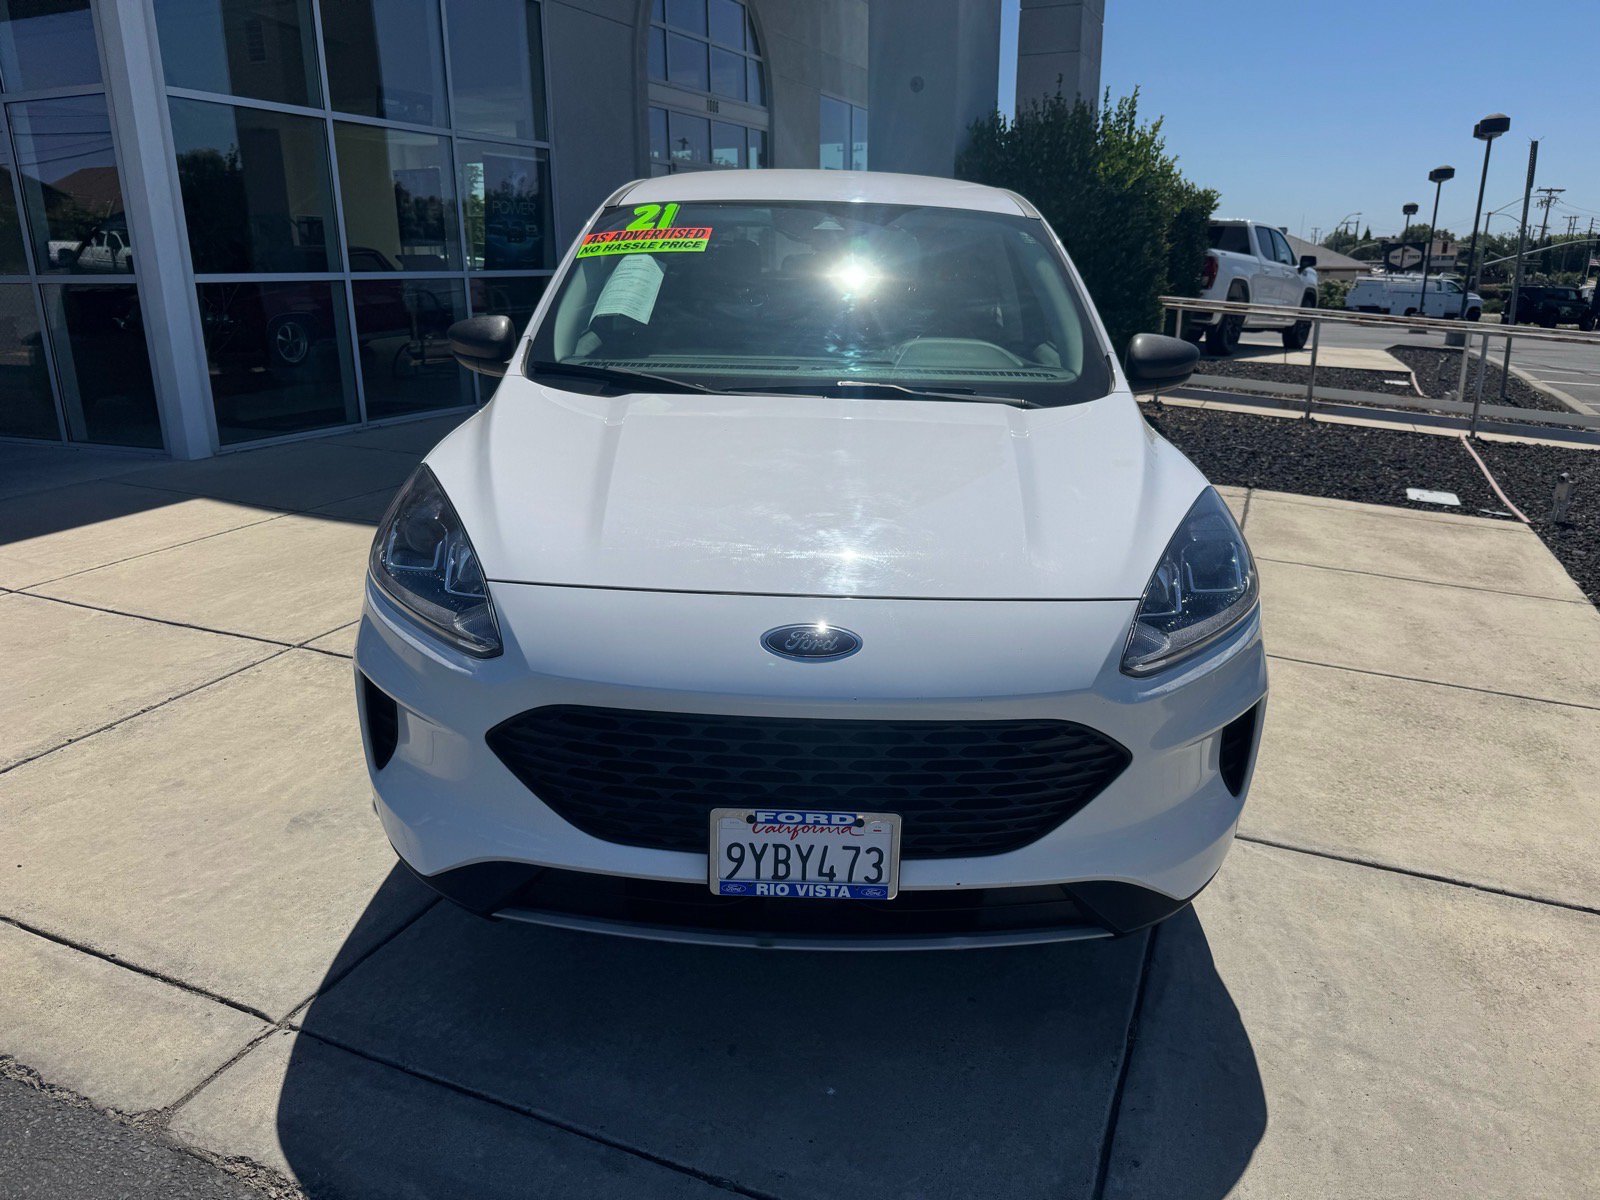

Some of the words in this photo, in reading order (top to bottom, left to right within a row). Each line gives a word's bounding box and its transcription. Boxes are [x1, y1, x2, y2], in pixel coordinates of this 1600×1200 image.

[491, 200, 536, 215] POWER
[626, 203, 680, 231] 21
[588, 234, 609, 245] AS
[612, 229, 705, 241] ADVERTISED
[580, 246, 601, 254] NO
[602, 241, 657, 252] HASSLE
[659, 240, 702, 249] PRICE
[784, 630, 839, 650] Ford
[756, 812, 857, 825] FORD
[752, 823, 865, 840] California
[726, 842, 884, 884] 9YBY473
[756, 883, 790, 896] RIO
[795, 884, 851, 898] VISTA
